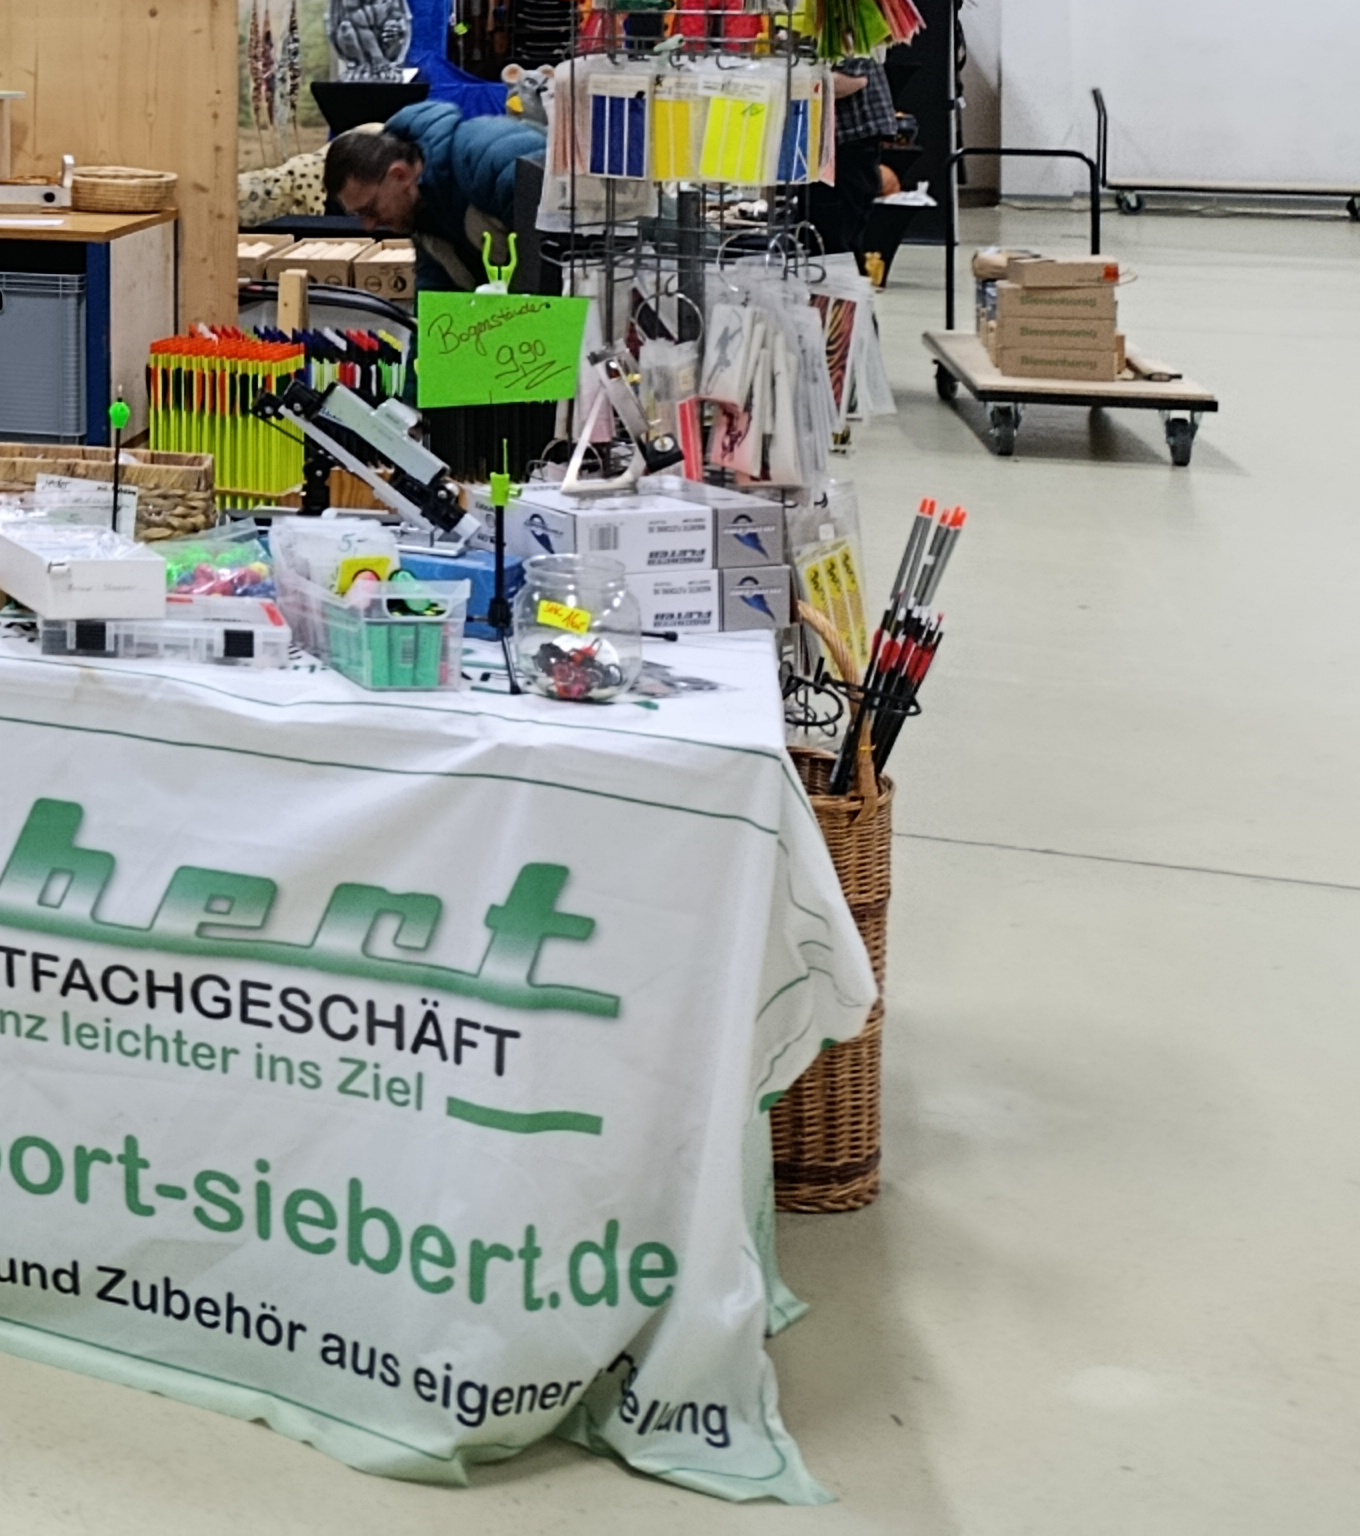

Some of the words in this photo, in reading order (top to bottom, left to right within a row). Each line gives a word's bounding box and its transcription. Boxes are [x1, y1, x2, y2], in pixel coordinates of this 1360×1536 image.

[62, 1010, 241, 1076] leichter
[254, 1042, 323, 1091] ins
[336, 1056, 425, 1111] Ziel
[95, 1264, 307, 1353] Zubehör
[320, 1328, 401, 1387] aus
[413, 1363, 583, 1428] eigener
